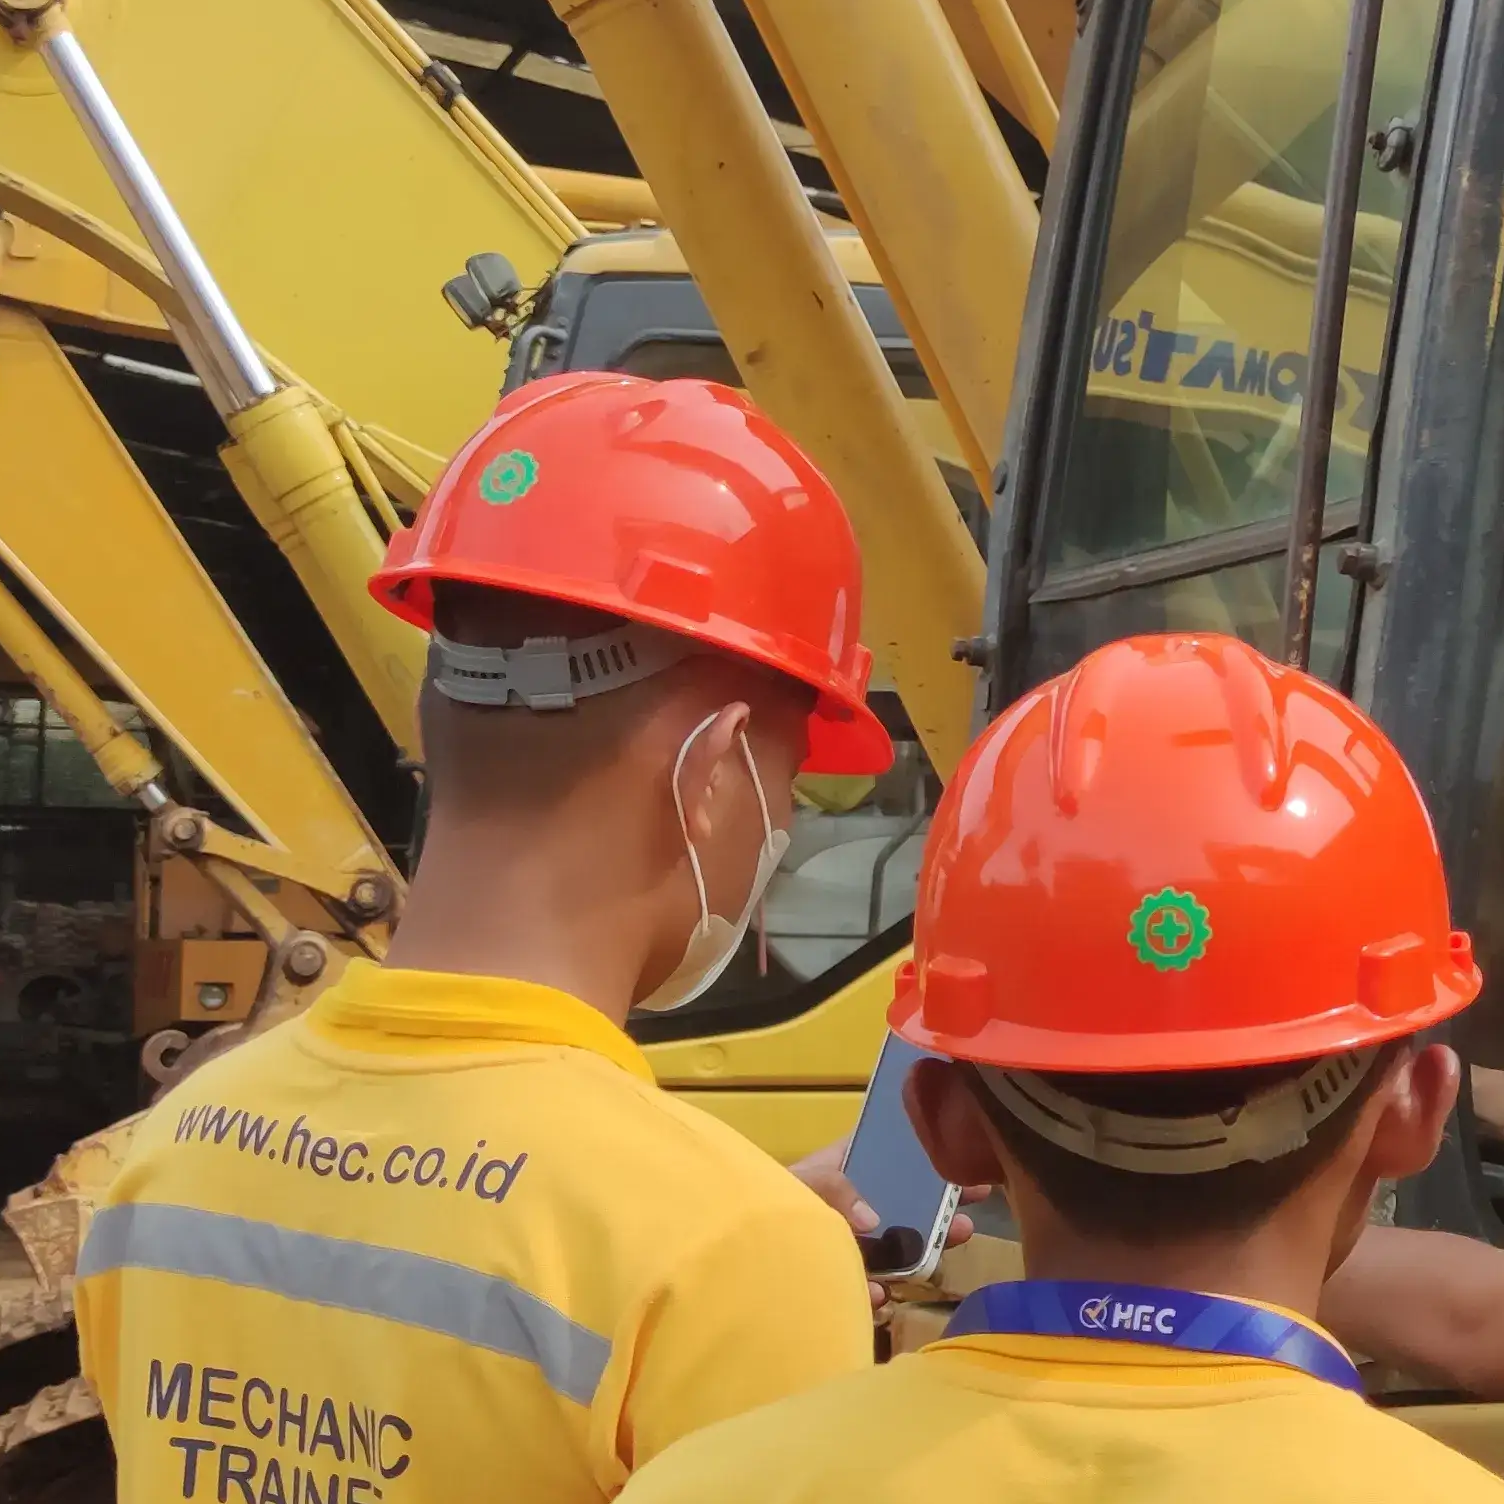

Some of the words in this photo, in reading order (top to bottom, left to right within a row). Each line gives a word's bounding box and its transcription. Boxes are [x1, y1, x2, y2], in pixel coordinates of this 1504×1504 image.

[174, 1103, 528, 1204] www.hec.co.id
[1111, 1301, 1177, 1335] HEC
[146, 1358, 413, 1480] MECHANIC
